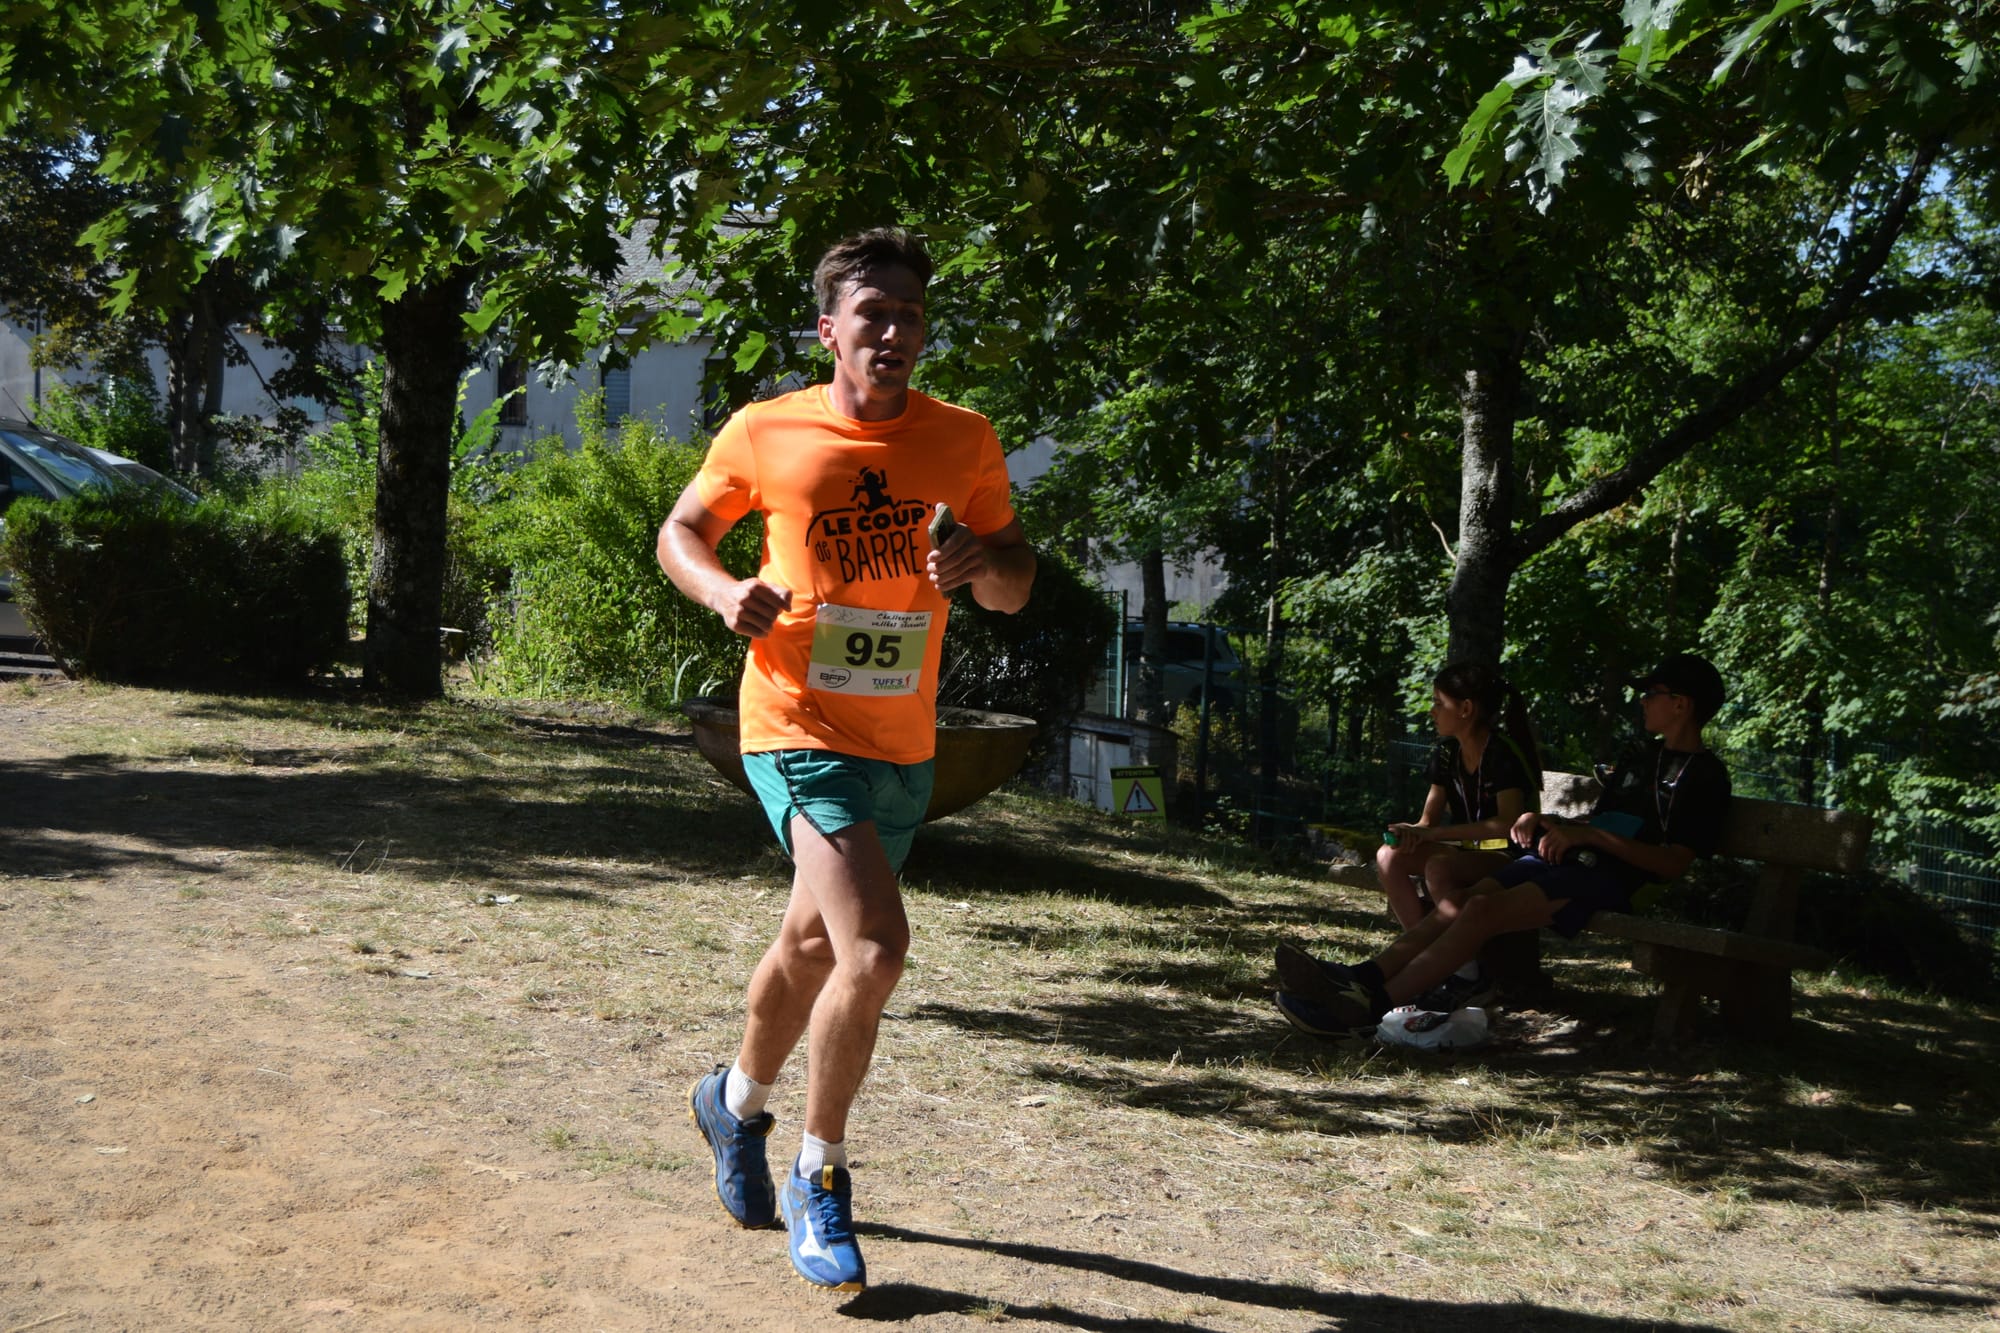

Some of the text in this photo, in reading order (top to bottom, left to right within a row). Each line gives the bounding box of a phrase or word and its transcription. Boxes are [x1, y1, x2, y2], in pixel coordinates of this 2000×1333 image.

[822, 507, 926, 537] LE COUP
[815, 528, 922, 584] de BARRE
[845, 632, 902, 668] 95
